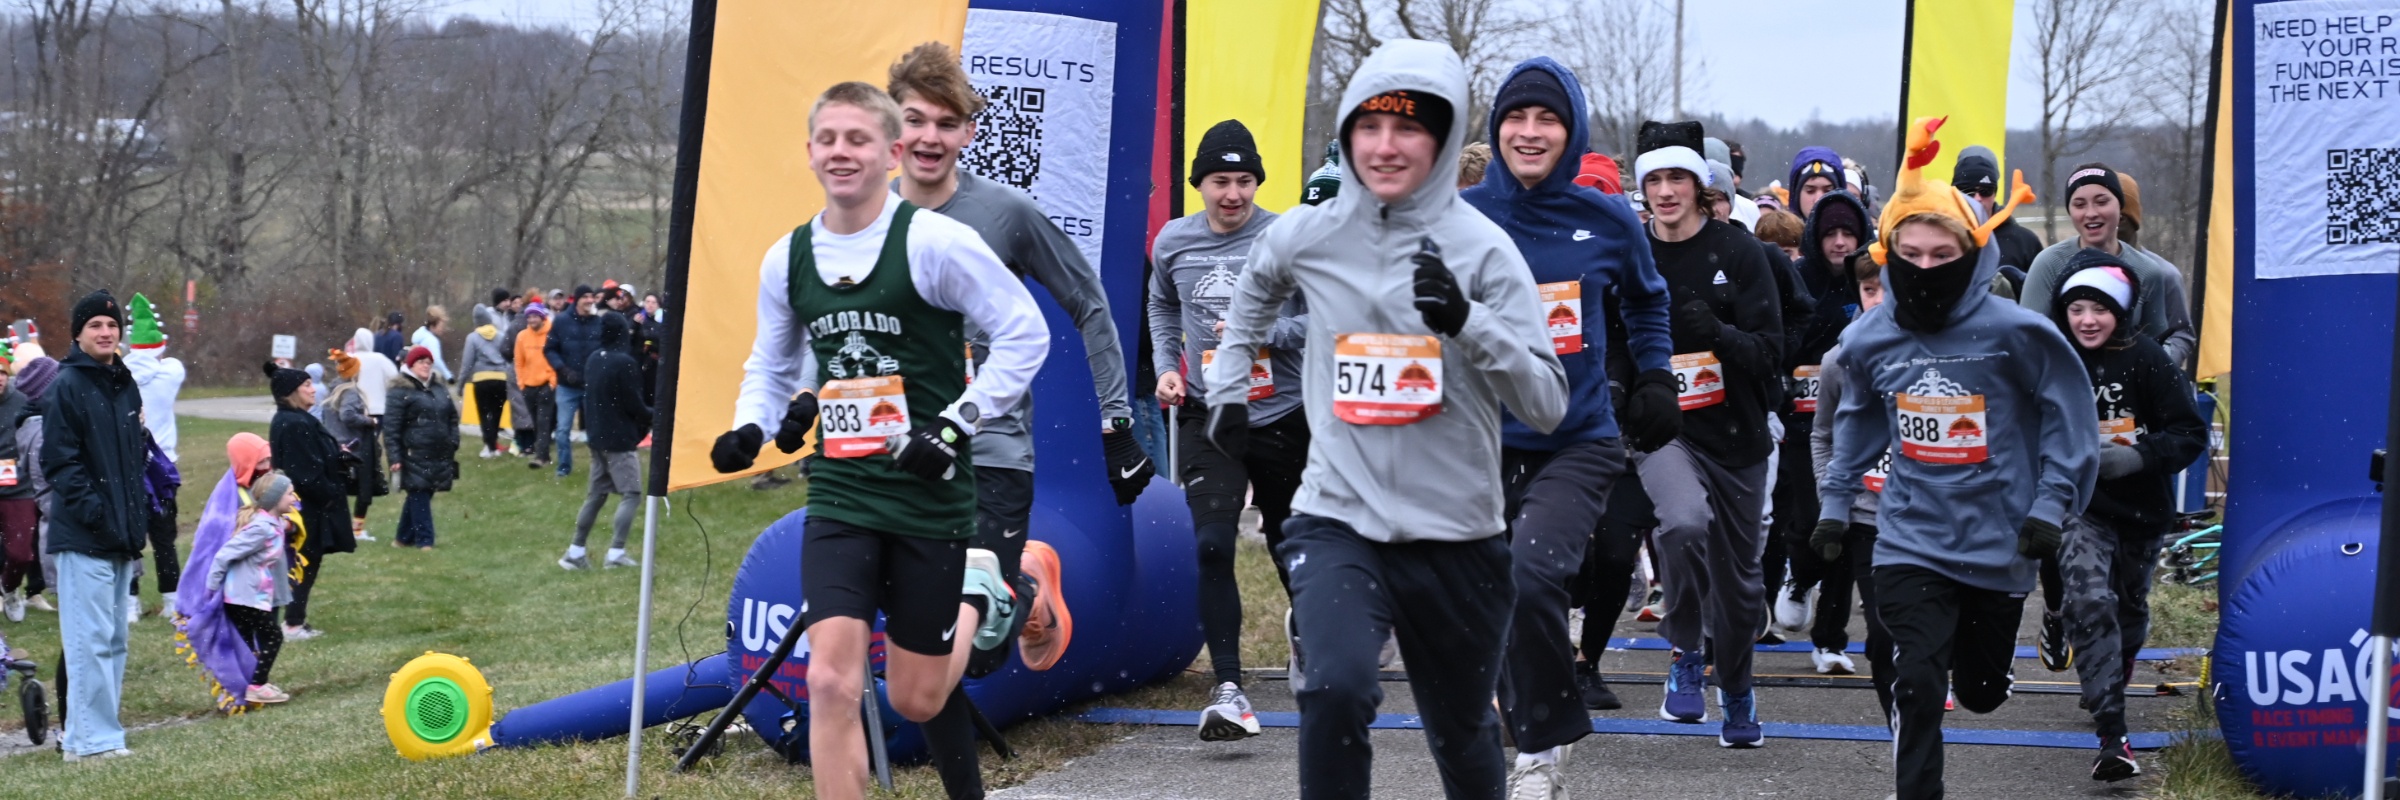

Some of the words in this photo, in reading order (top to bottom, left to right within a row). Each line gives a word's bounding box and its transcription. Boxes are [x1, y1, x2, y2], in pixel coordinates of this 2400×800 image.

[2262, 18, 2317, 40] NEED
[2326, 15, 2392, 35] HELP
[2301, 38, 2371, 58] YOUR
[971, 55, 1095, 83] RESULTS
[2268, 83, 2310, 103] THE
[2318, 80, 2390, 101] NEXT
[1307, 187, 1320, 200] E
[810, 310, 902, 339] COLORADO
[1338, 362, 1386, 396] 574
[822, 404, 862, 433] 383
[1900, 413, 1940, 442] 388
[2245, 648, 2357, 706] USA
[2252, 709, 2293, 727] RACE
[2296, 707, 2354, 725] TIMING
